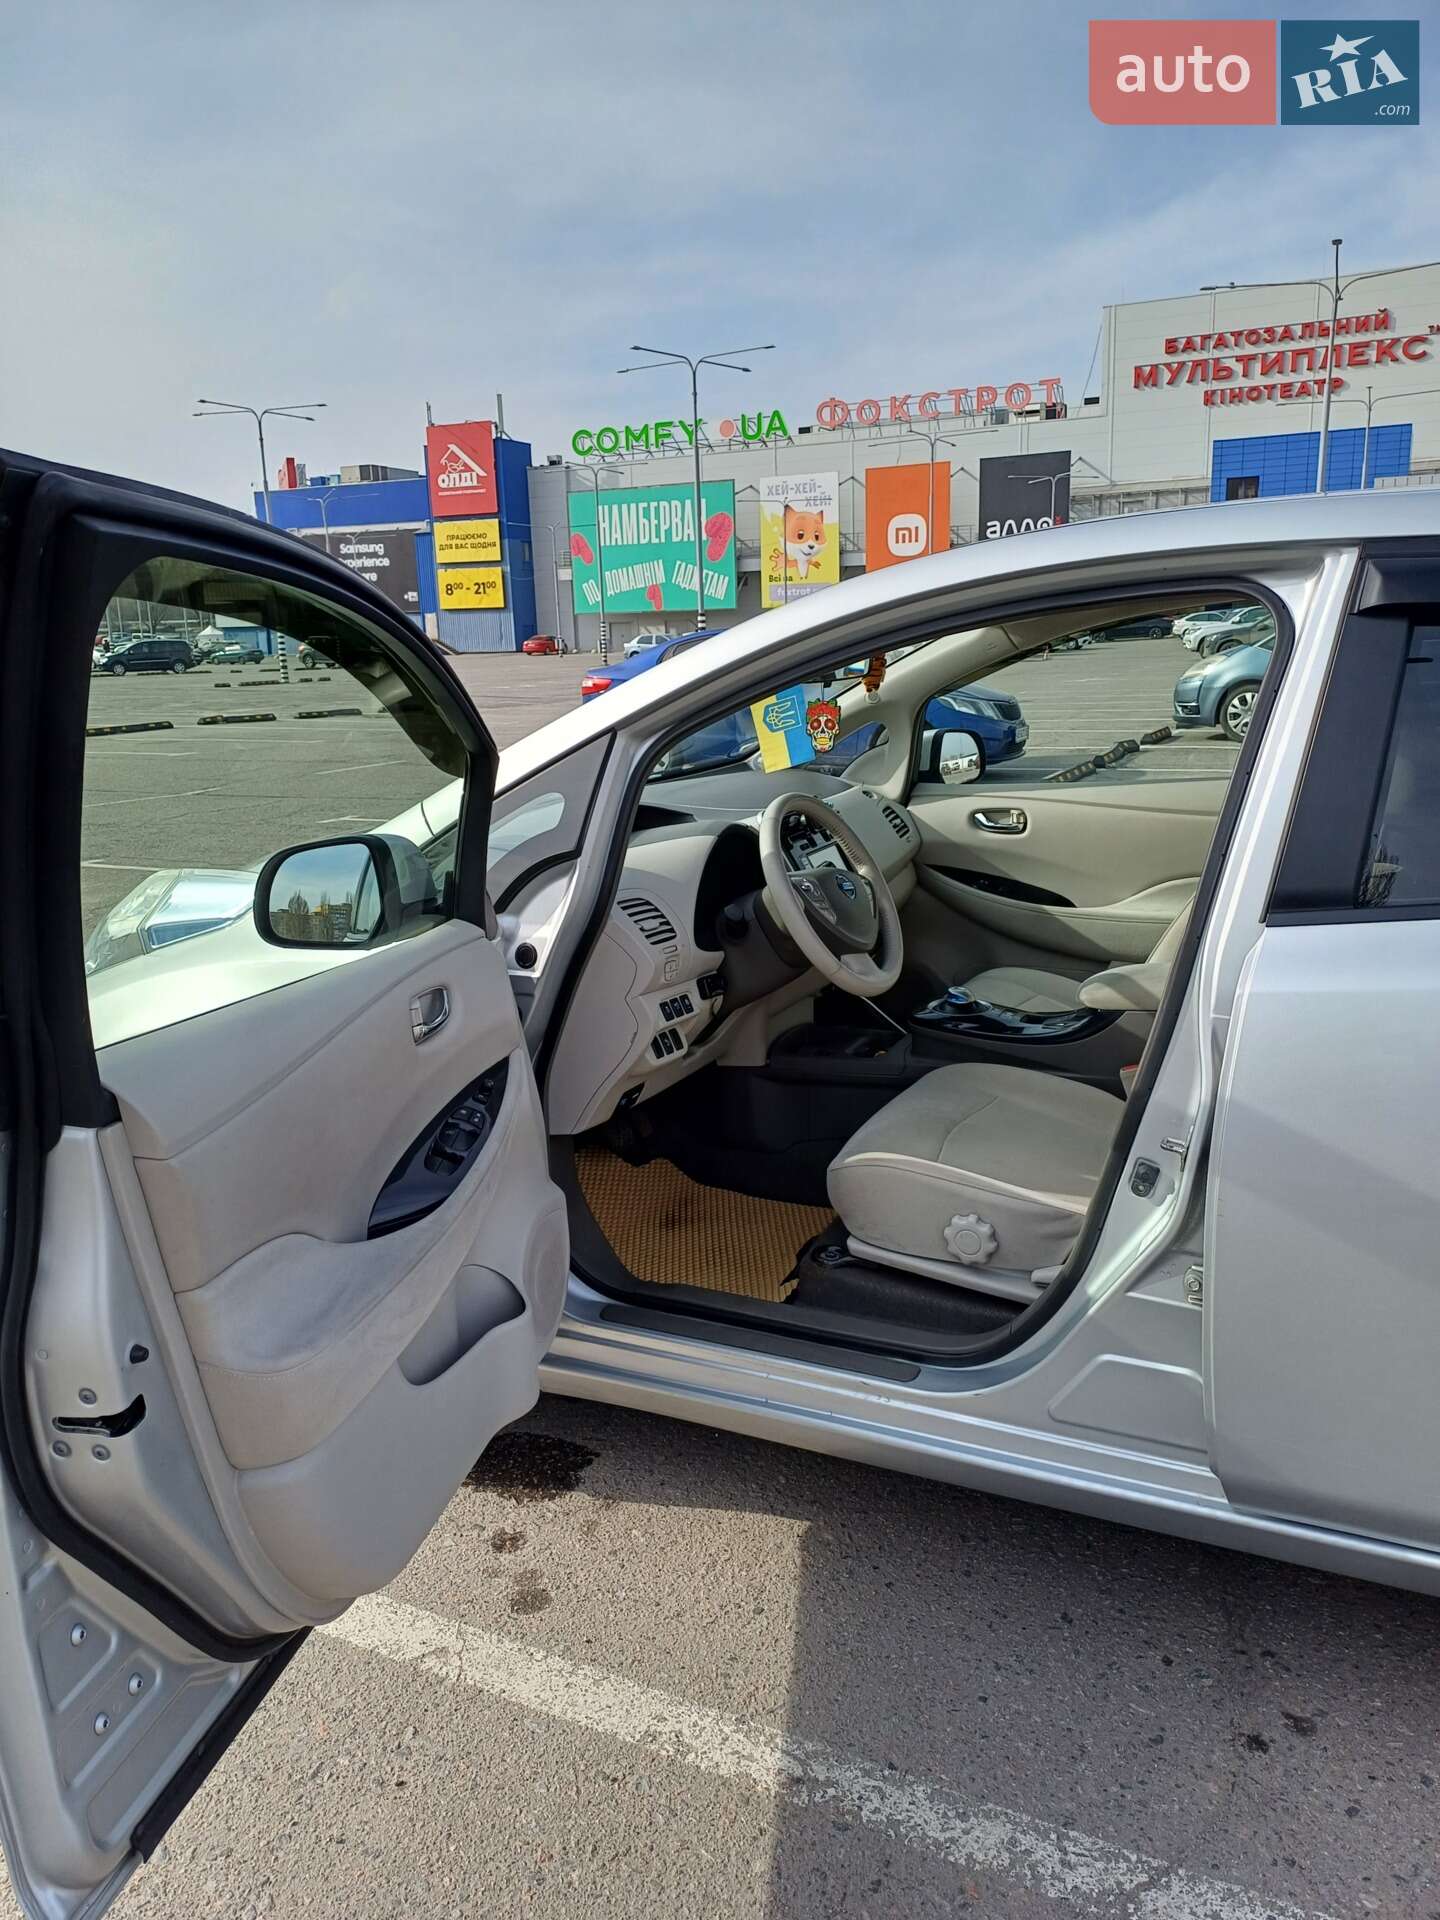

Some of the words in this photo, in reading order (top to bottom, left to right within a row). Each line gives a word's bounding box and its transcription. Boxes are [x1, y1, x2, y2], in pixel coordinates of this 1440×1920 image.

[1164, 307, 1391, 355] БАГАТОЗАЛЬНИЙ
[1133, 335, 1428, 390] МУЛЬТИПЛЕКС
[816, 377, 1061, 431] ФОКСТРОТ
[1203, 377, 1345, 407] КІНОТЕАТР
[571, 417, 704, 457] COMFY
[339, 543, 384, 555] Samsung
[455, 542, 469, 550] ВАС
[582, 579, 601, 605] ПО
[604, 559, 666, 598] ДОМАШНІМ
